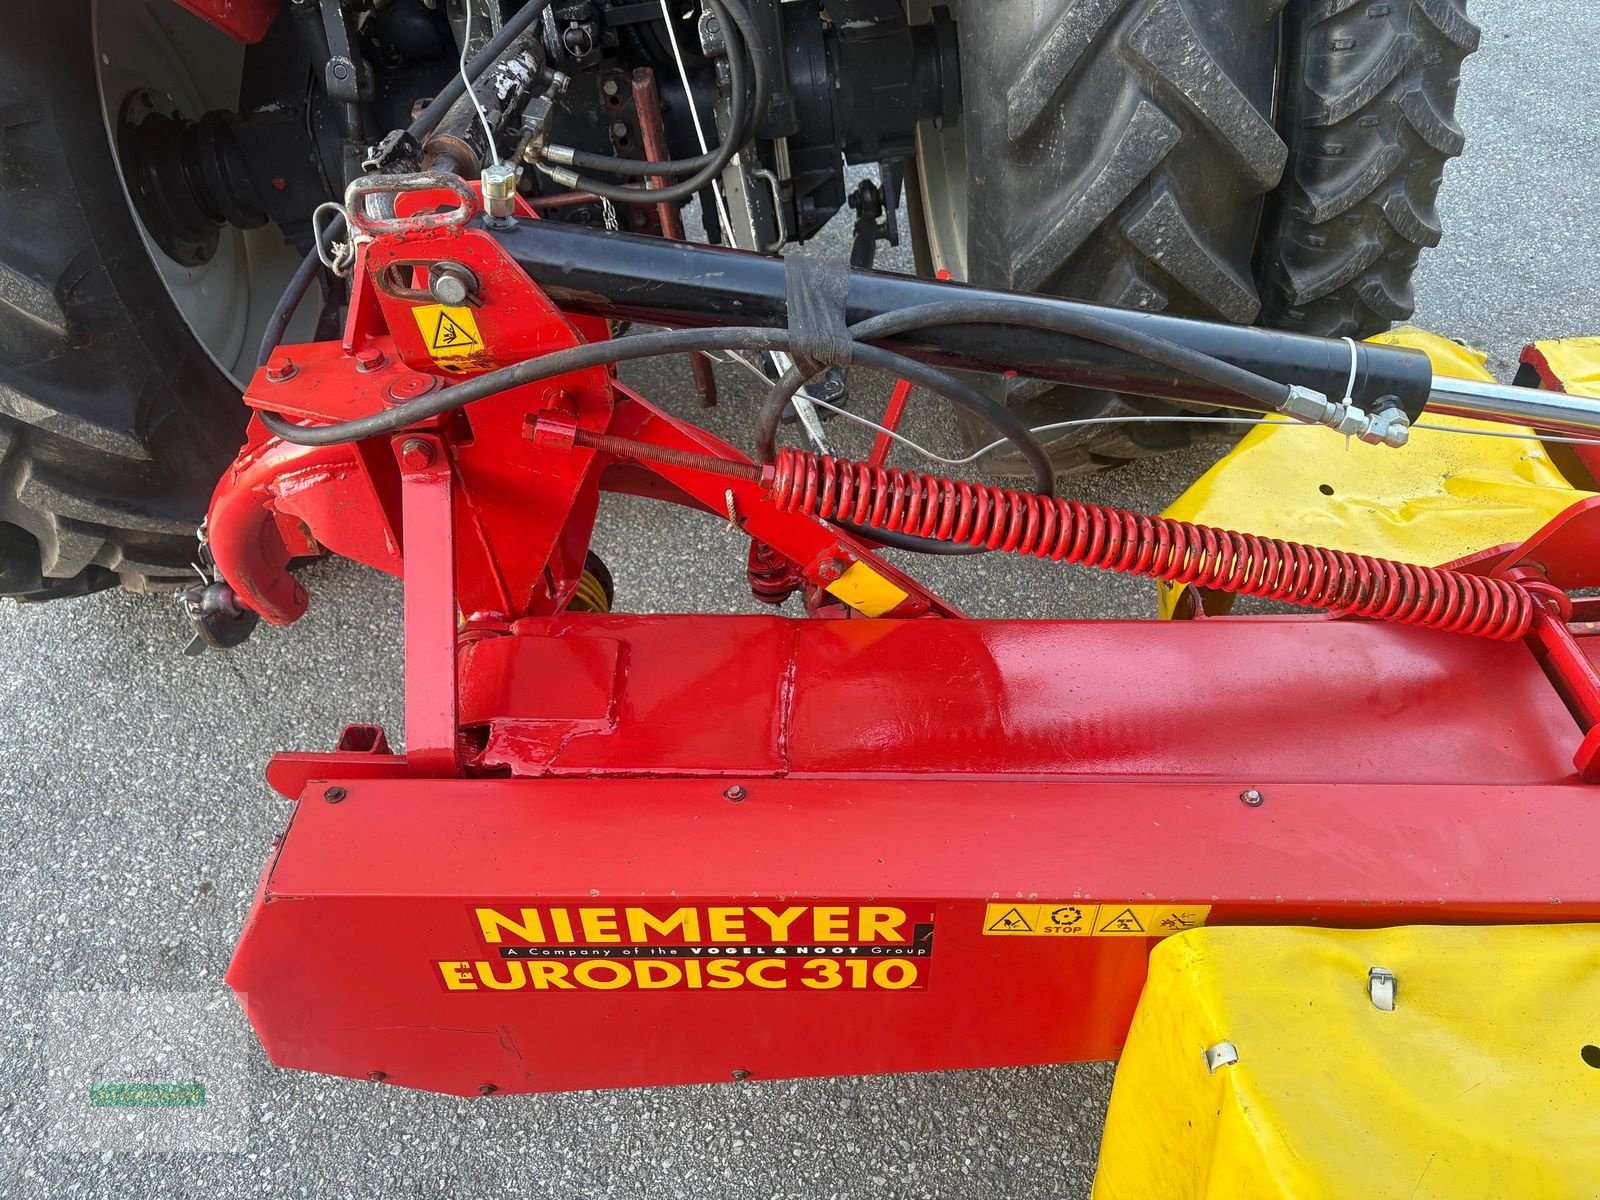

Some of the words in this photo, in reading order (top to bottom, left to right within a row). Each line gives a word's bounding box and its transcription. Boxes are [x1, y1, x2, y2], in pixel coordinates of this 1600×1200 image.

[476, 906, 907, 943] NIEMEYER
[1043, 926, 1082, 934] STOP
[507, 948, 518, 956] A
[529, 948, 611, 957] Company
[622, 947, 640, 956] of
[650, 947, 678, 956] the
[690, 947, 766, 955] VOGEL
[796, 946, 859, 954] NOOT
[871, 946, 926, 956] Group
[439, 958, 788, 990] EURODISC
[800, 958, 918, 990] 310
